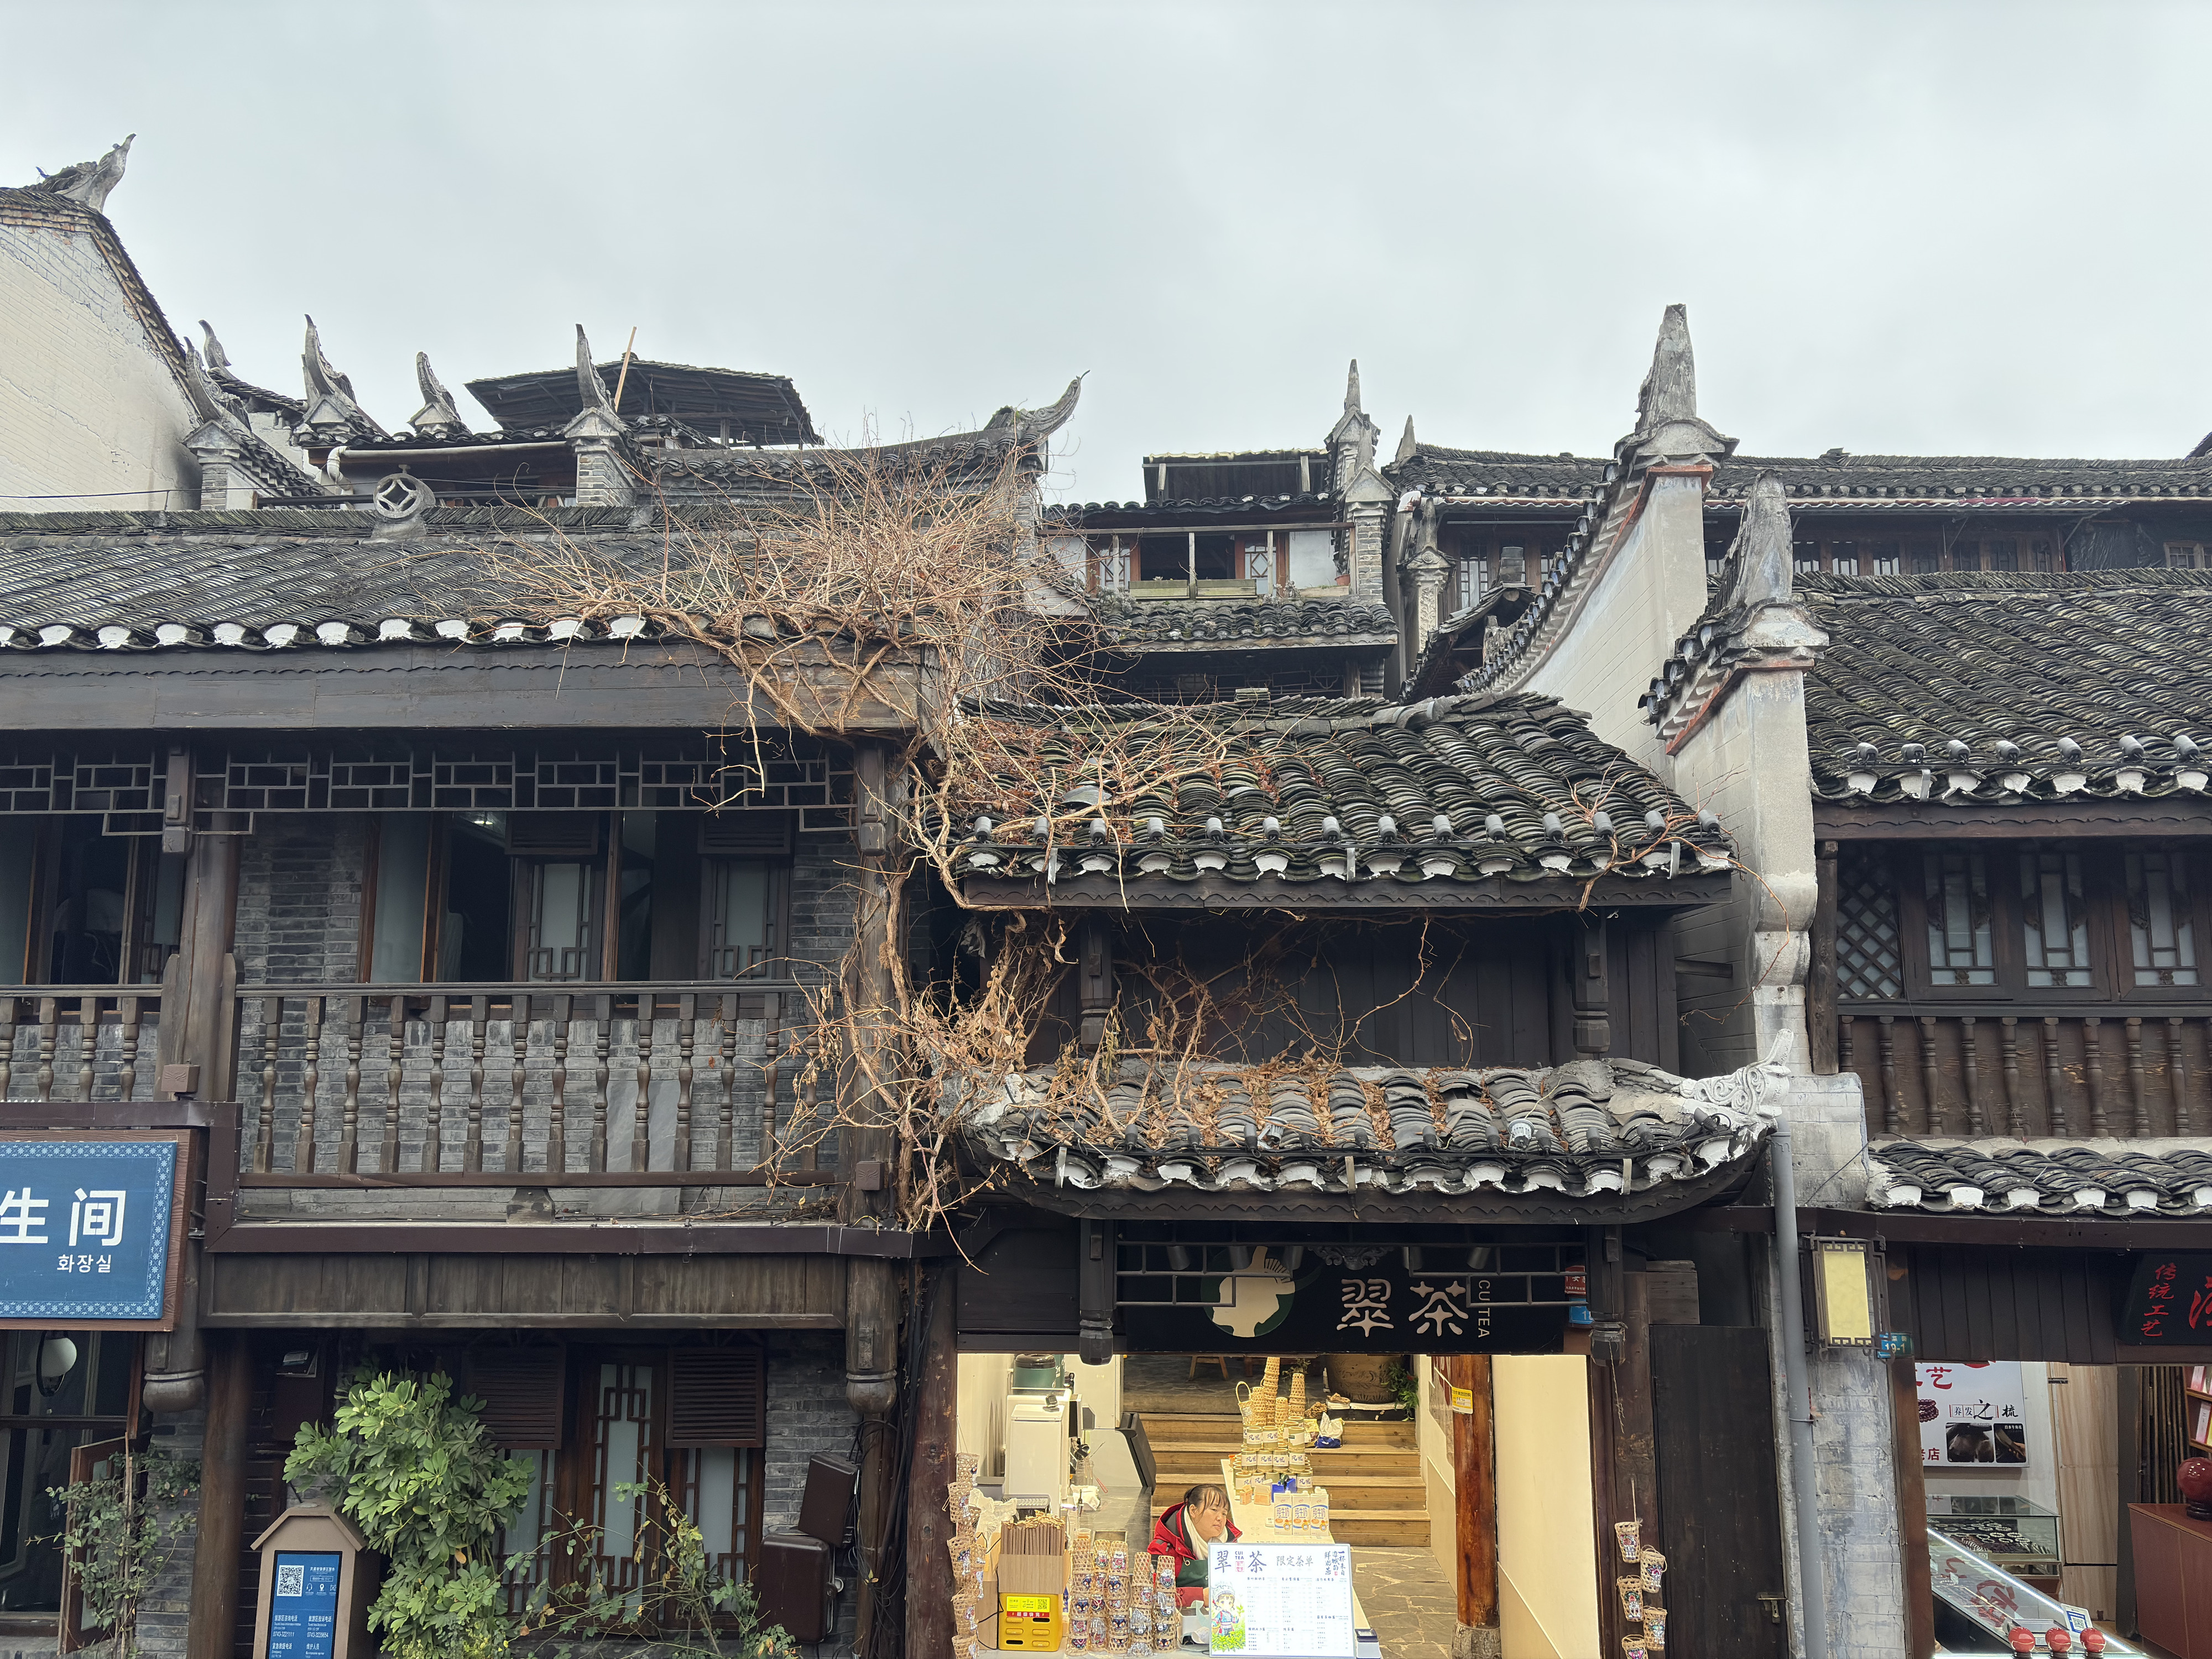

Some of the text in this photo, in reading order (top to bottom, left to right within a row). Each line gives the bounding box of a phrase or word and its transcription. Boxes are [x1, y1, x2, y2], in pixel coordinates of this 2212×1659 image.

[0, 1187, 126, 1246] 生间
[57, 1254, 111, 1273] 화장실
[1336, 1279, 1469, 1337] 翠茶
[1478, 1280, 1490, 1338] CU TEA
[2141, 1262, 2177, 1337] 传统工艺
[1276, 1507, 1290, 1517] 纯牛奶
[1295, 1507, 1308, 1517] 纯牛奶
[1313, 1507, 1326, 1517] 纯牛奶
[1215, 1550, 1232, 1573] 翠
[1248, 1550, 1267, 1574] 茶
[1276, 1555, 1314, 1567] 限定茶单
